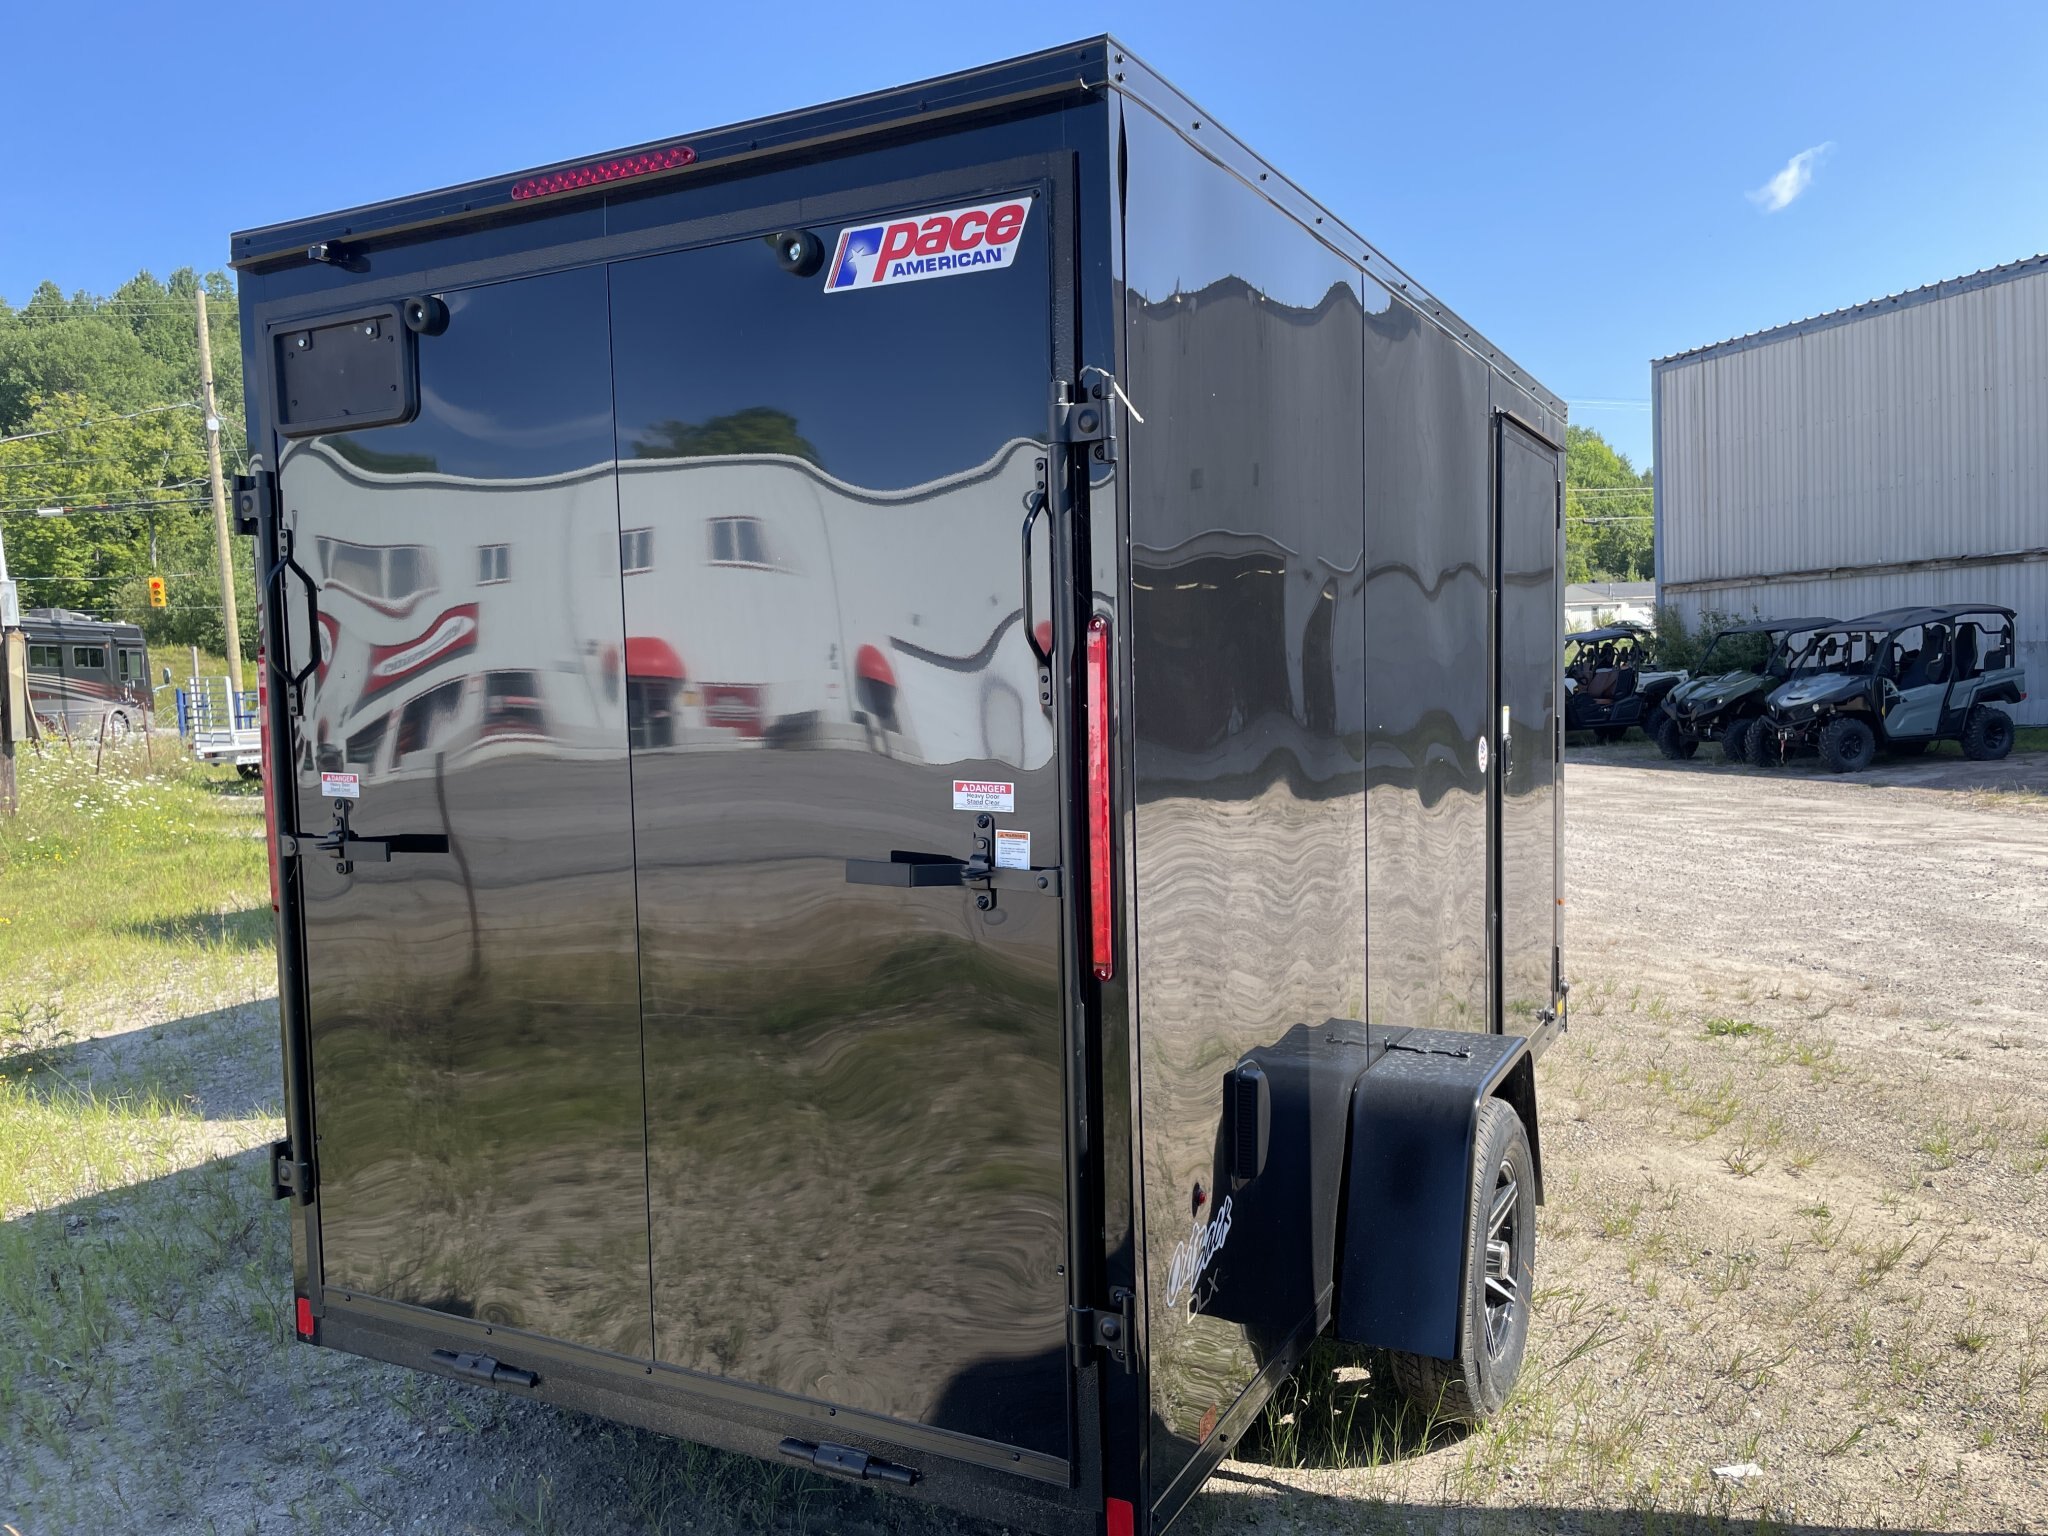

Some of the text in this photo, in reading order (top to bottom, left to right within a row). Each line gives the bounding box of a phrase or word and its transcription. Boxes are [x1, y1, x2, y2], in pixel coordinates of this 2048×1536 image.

[872, 204, 1025, 282] pace
[892, 247, 1002, 278] AMERICAN
[331, 775, 354, 783] DANGER
[969, 784, 1006, 793] DANGER
[1187, 1267, 1220, 1325] DLX
